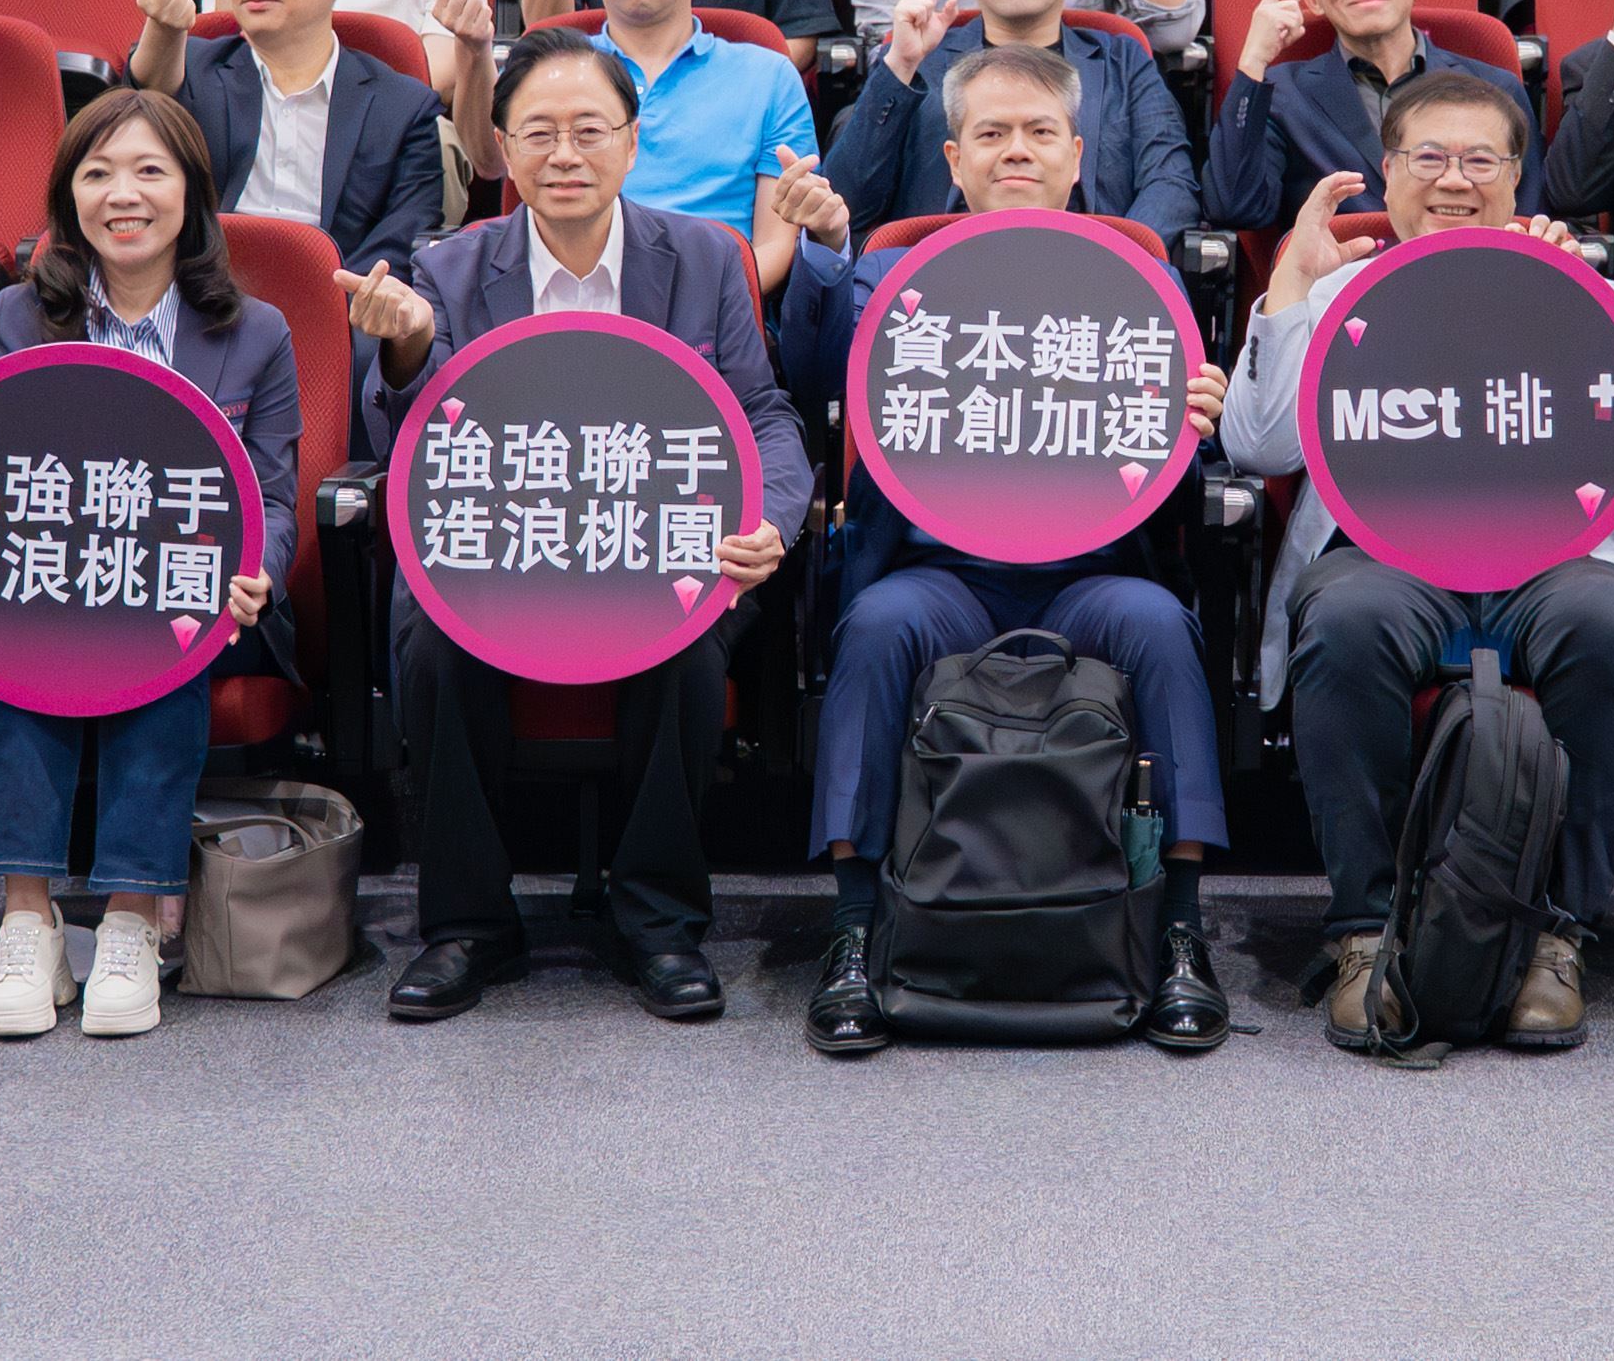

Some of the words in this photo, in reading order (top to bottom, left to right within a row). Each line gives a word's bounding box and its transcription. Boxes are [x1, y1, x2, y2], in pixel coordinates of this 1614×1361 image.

[884, 307, 1176, 387] 資本鏈結
[425, 418, 728, 496] 強強聯手
[878, 383, 1171, 460] 新創加速
[421, 496, 724, 575] 造浪桃園
